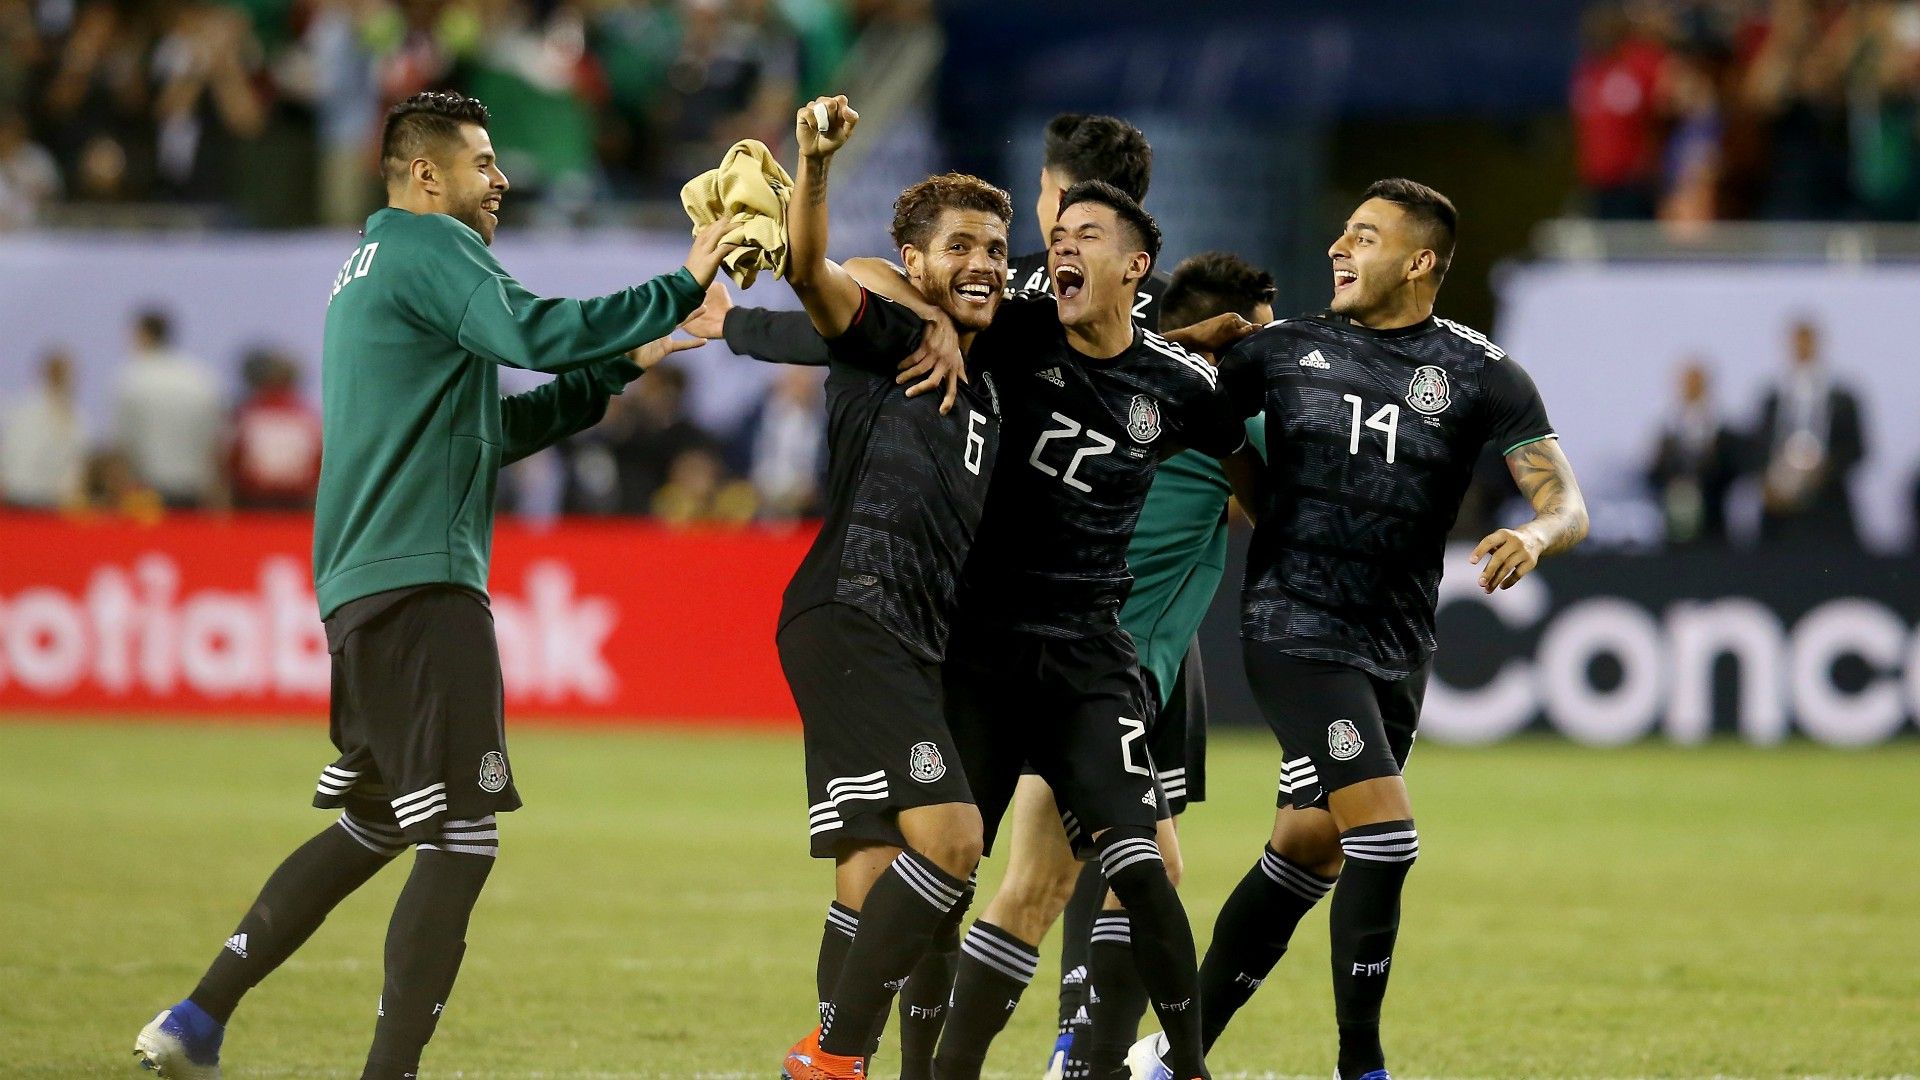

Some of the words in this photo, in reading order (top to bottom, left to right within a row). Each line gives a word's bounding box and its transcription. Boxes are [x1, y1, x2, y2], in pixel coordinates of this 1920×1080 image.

[1299, 358, 1331, 370] adidas
[964, 409, 987, 476] 6
[1029, 411, 1116, 493] 22
[1343, 393, 1400, 464] 14
[1418, 542, 1920, 748] Conc
[1118, 716, 1155, 781] 2
[1351, 956, 1391, 977] FMF
[910, 1004, 942, 1020] FMF
[1160, 998, 1191, 1012] FMF
